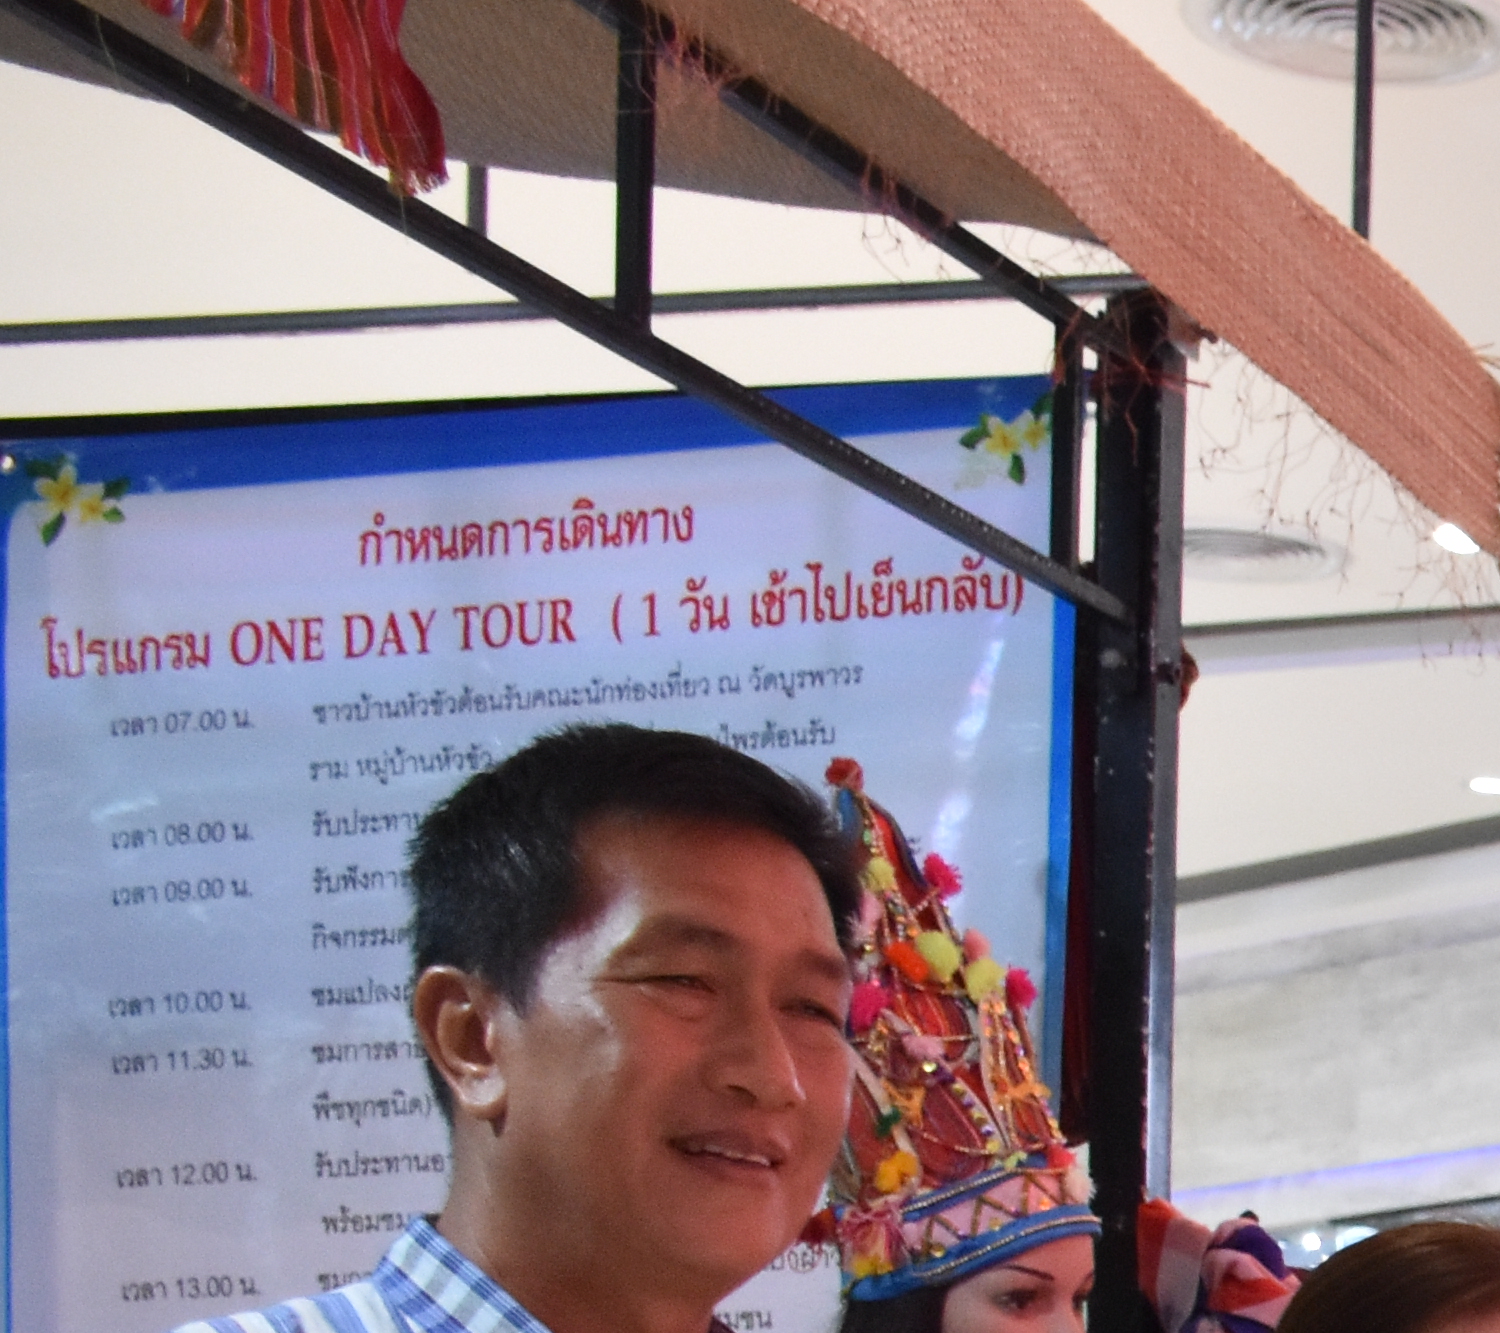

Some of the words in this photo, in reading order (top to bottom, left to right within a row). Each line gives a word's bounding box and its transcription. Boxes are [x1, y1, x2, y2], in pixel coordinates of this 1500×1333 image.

[358, 496, 695, 568] กำหนดการเดินทาง
[41, 615, 212, 680] โปรแกรม
[229, 617, 325, 667] ONE
[342, 608, 437, 660] DAY
[453, 597, 577, 653] TOUR
[643, 593, 661, 638] 1
[679, 576, 731, 634] วัน
[163, 709, 227, 735] 07.00
